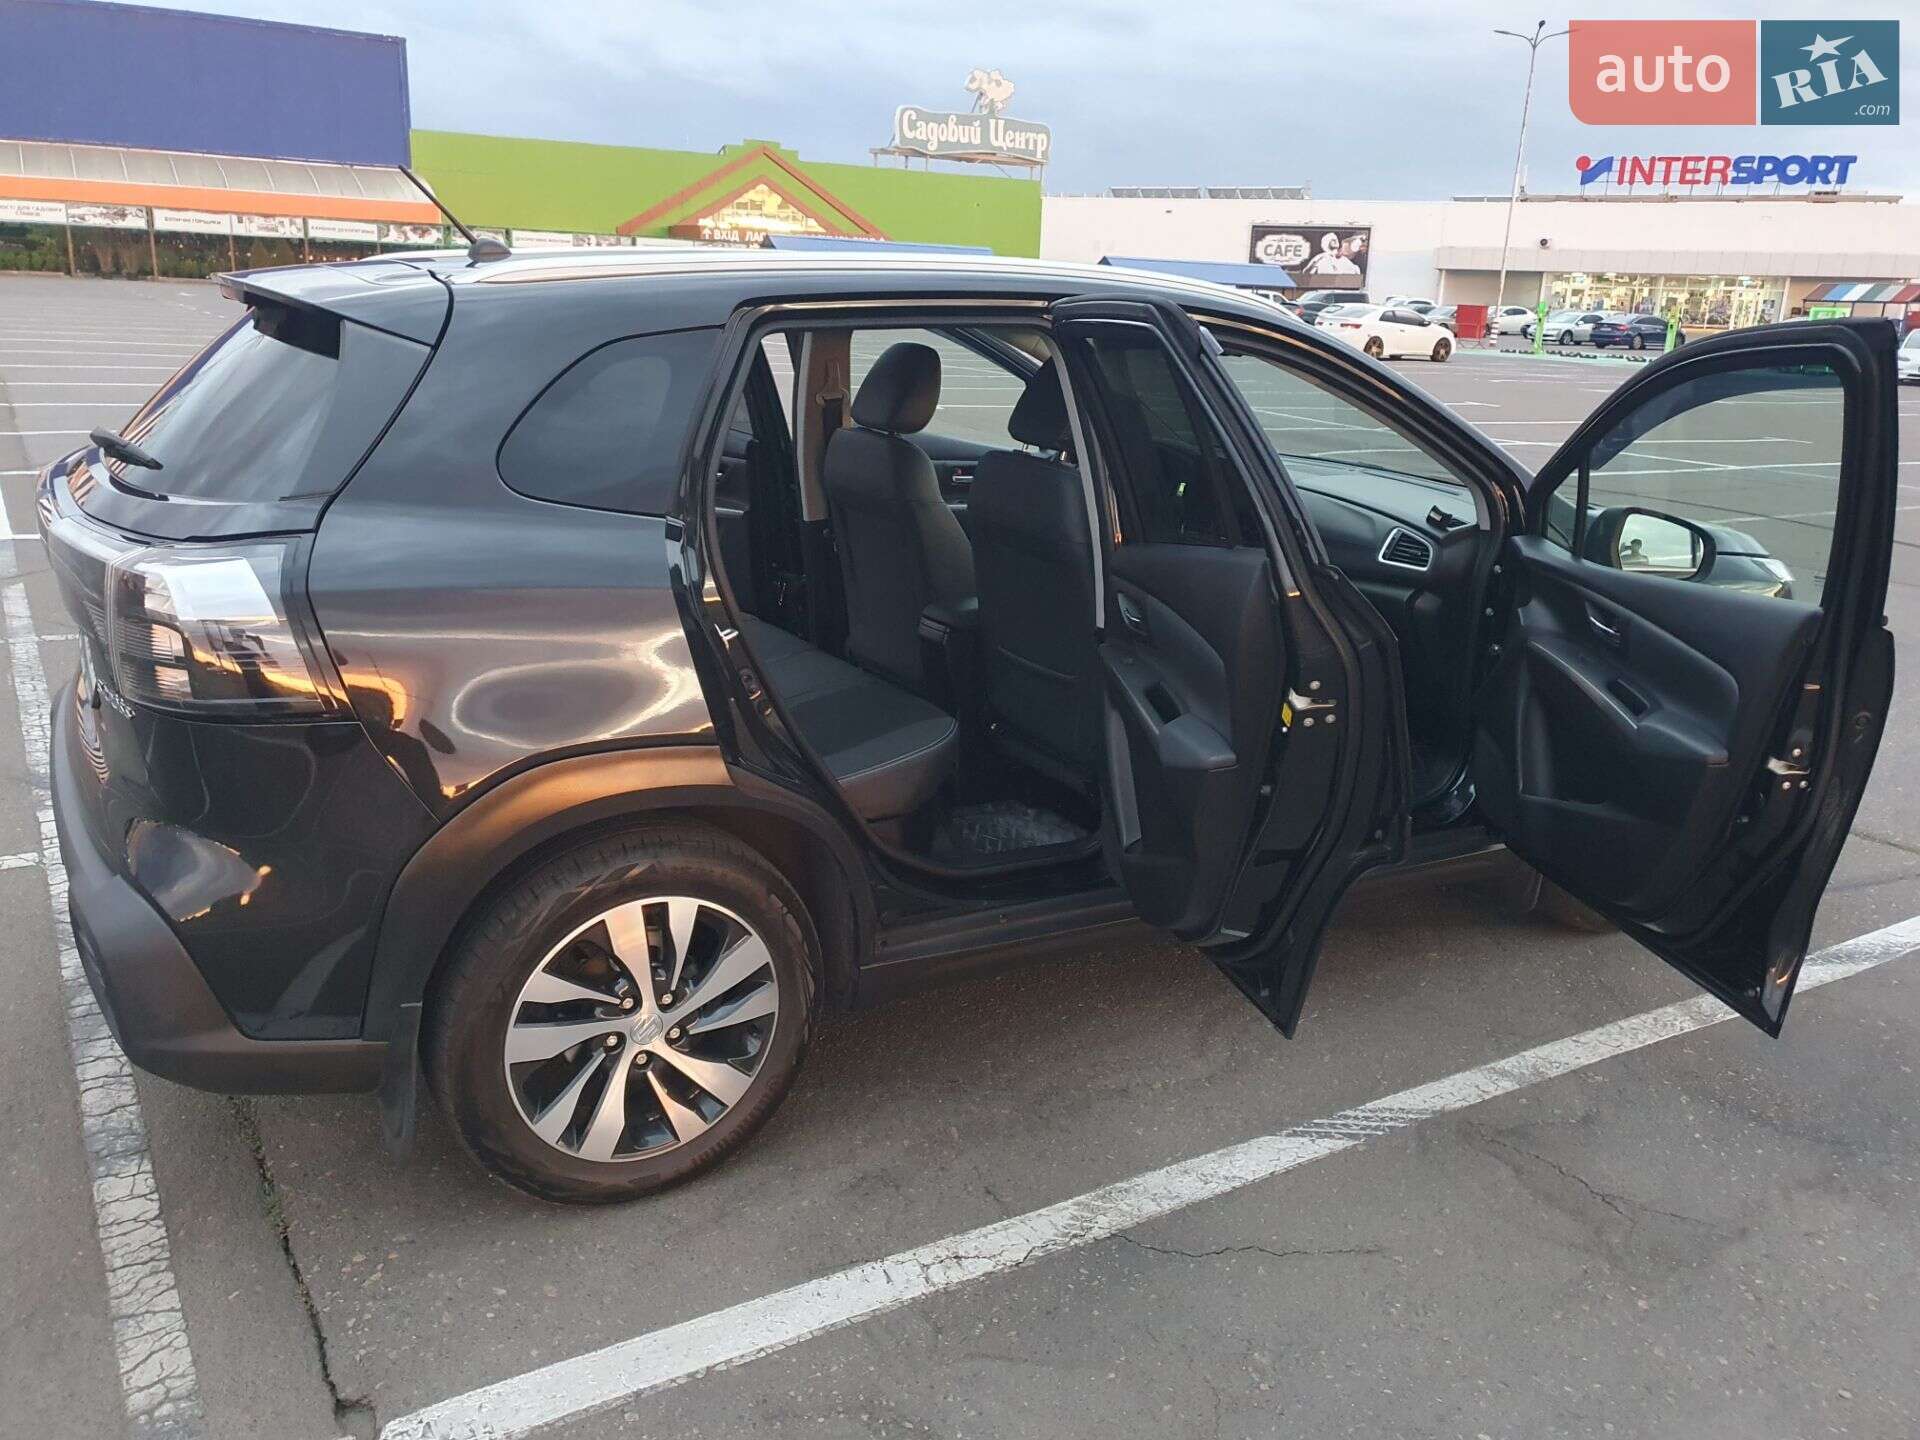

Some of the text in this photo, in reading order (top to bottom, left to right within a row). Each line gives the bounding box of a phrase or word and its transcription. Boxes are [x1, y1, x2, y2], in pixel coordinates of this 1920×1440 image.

[902, 110, 1047, 158] Садовий Центр
[1617, 155, 1857, 185] INTERSPORT
[1263, 244, 1303, 257] CAFE
